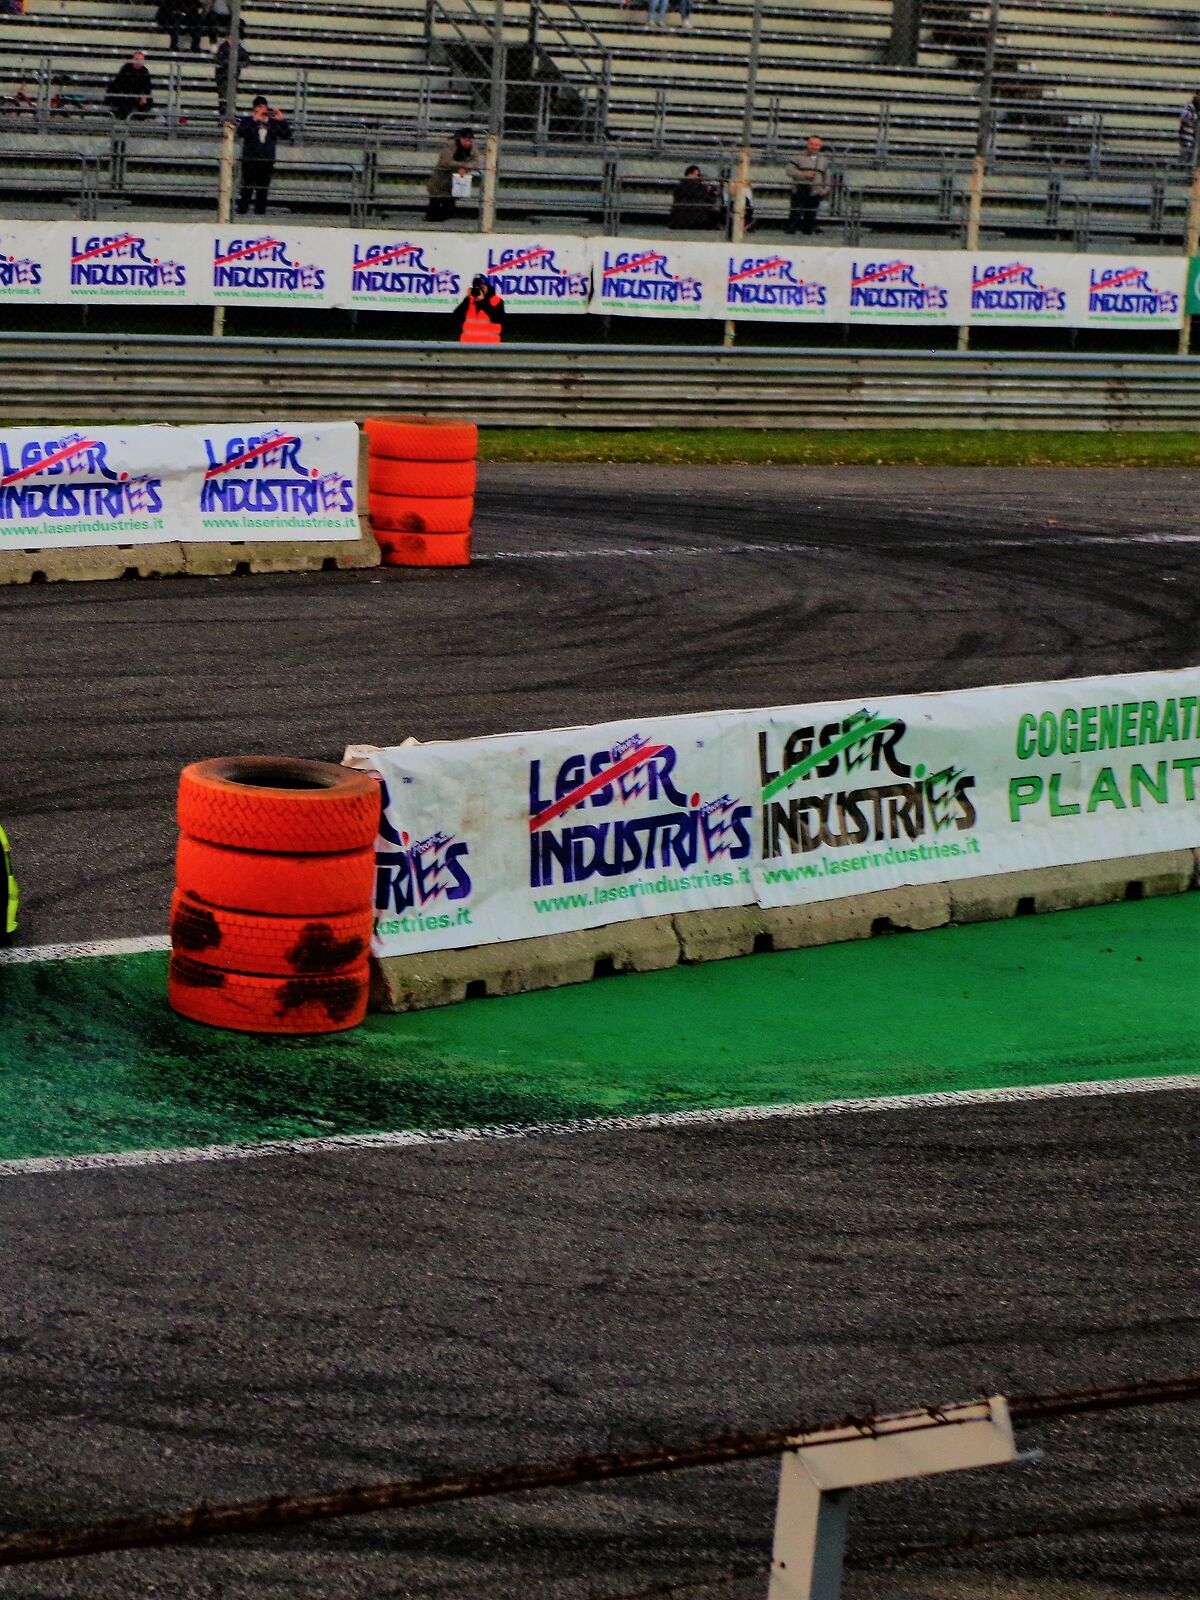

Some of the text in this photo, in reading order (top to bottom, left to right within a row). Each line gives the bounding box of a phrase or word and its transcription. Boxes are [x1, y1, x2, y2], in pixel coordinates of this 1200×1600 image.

[70, 233, 153, 264] LASER
[213, 236, 292, 267] LASER
[352, 242, 428, 272] LASER
[487, 246, 557, 275] LASER
[70, 261, 188, 287] INDUSTRIES
[213, 264, 326, 290] INDUSTRIES
[601, 250, 672, 279] LASER
[727, 256, 798, 285] LASER
[850, 260, 919, 288] LASER
[971, 264, 1038, 292] LASER
[352, 270, 461, 295] INDUSTRIES
[601, 277, 703, 302] INDUSTRIES
[1088, 266, 1152, 293] LASER
[727, 283, 828, 307] INDUSTRIES
[850, 285, 949, 309] INDUSTRIES
[971, 289, 1067, 313] INDUSTRIES
[1088, 291, 1179, 314] INDUSTRIES
[0, 433, 119, 481] LASER
[205, 429, 310, 477] LASER
[201, 471, 354, 516] INDUSTRIES
[0, 518, 164, 536] www.laserindustries.it
[203, 515, 356, 531] www.laserindustries.it
[759, 707, 911, 788] LASER
[529, 733, 689, 816] LASER
[1009, 757, 1200, 822] PLANT
[763, 766, 975, 859] INDUSTRIES
[530, 794, 752, 887] INDUSTRIES
[763, 837, 981, 885] www.laserindustries.it
[534, 867, 751, 913] www.laserindustries.it
